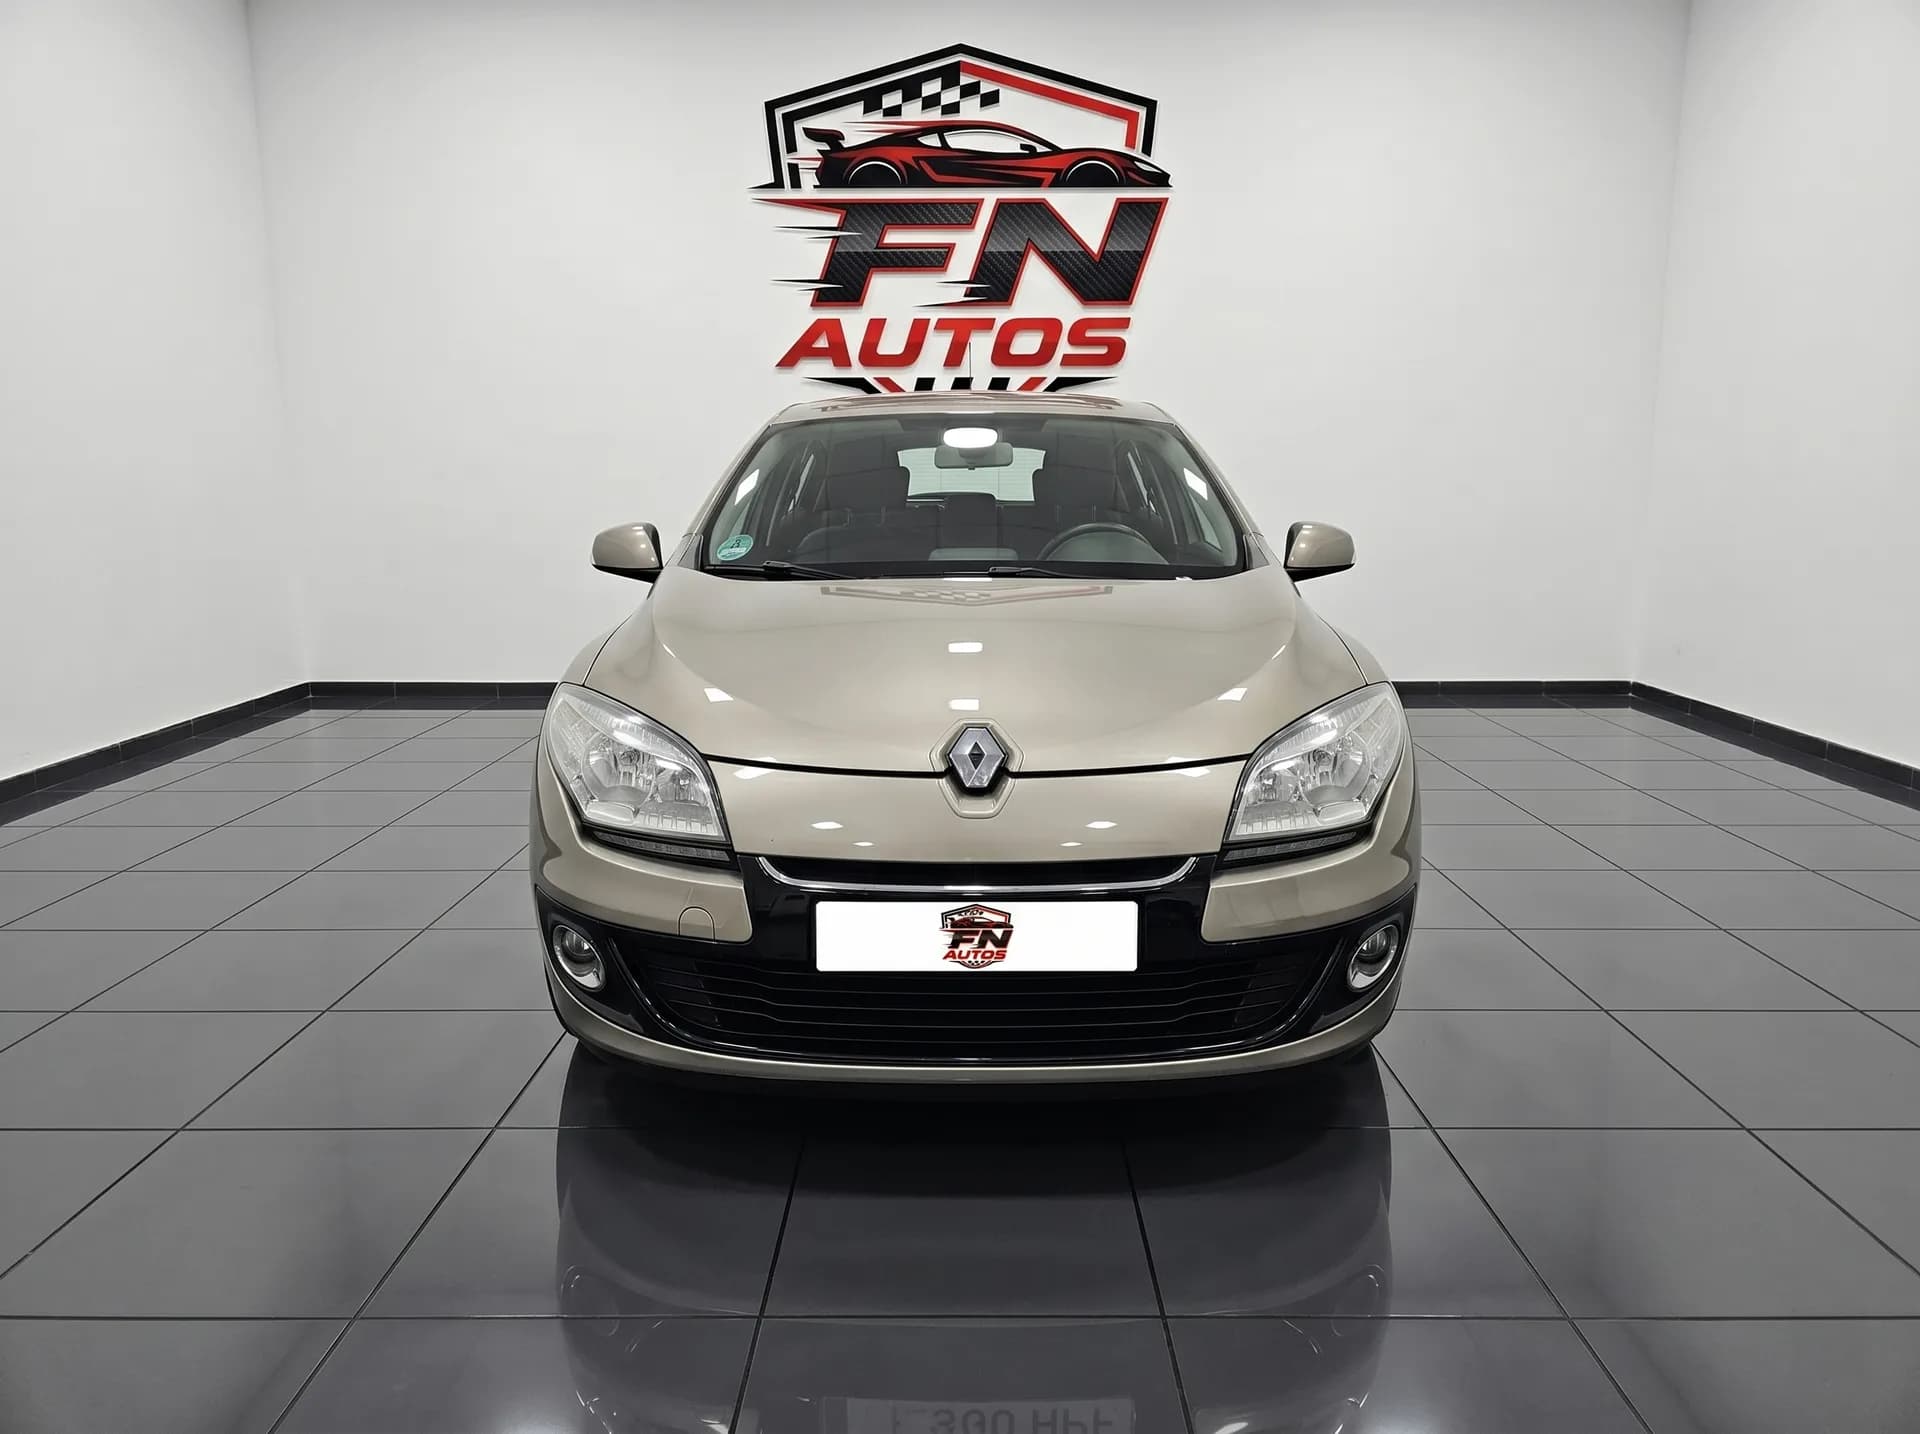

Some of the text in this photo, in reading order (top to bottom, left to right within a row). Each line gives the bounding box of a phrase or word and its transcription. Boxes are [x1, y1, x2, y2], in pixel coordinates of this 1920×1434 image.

[784, 197, 1170, 308] FN
[775, 316, 1132, 369] AUTOS
[942, 949, 1008, 960] AUTOS
[944, 929, 1014, 949] FN
